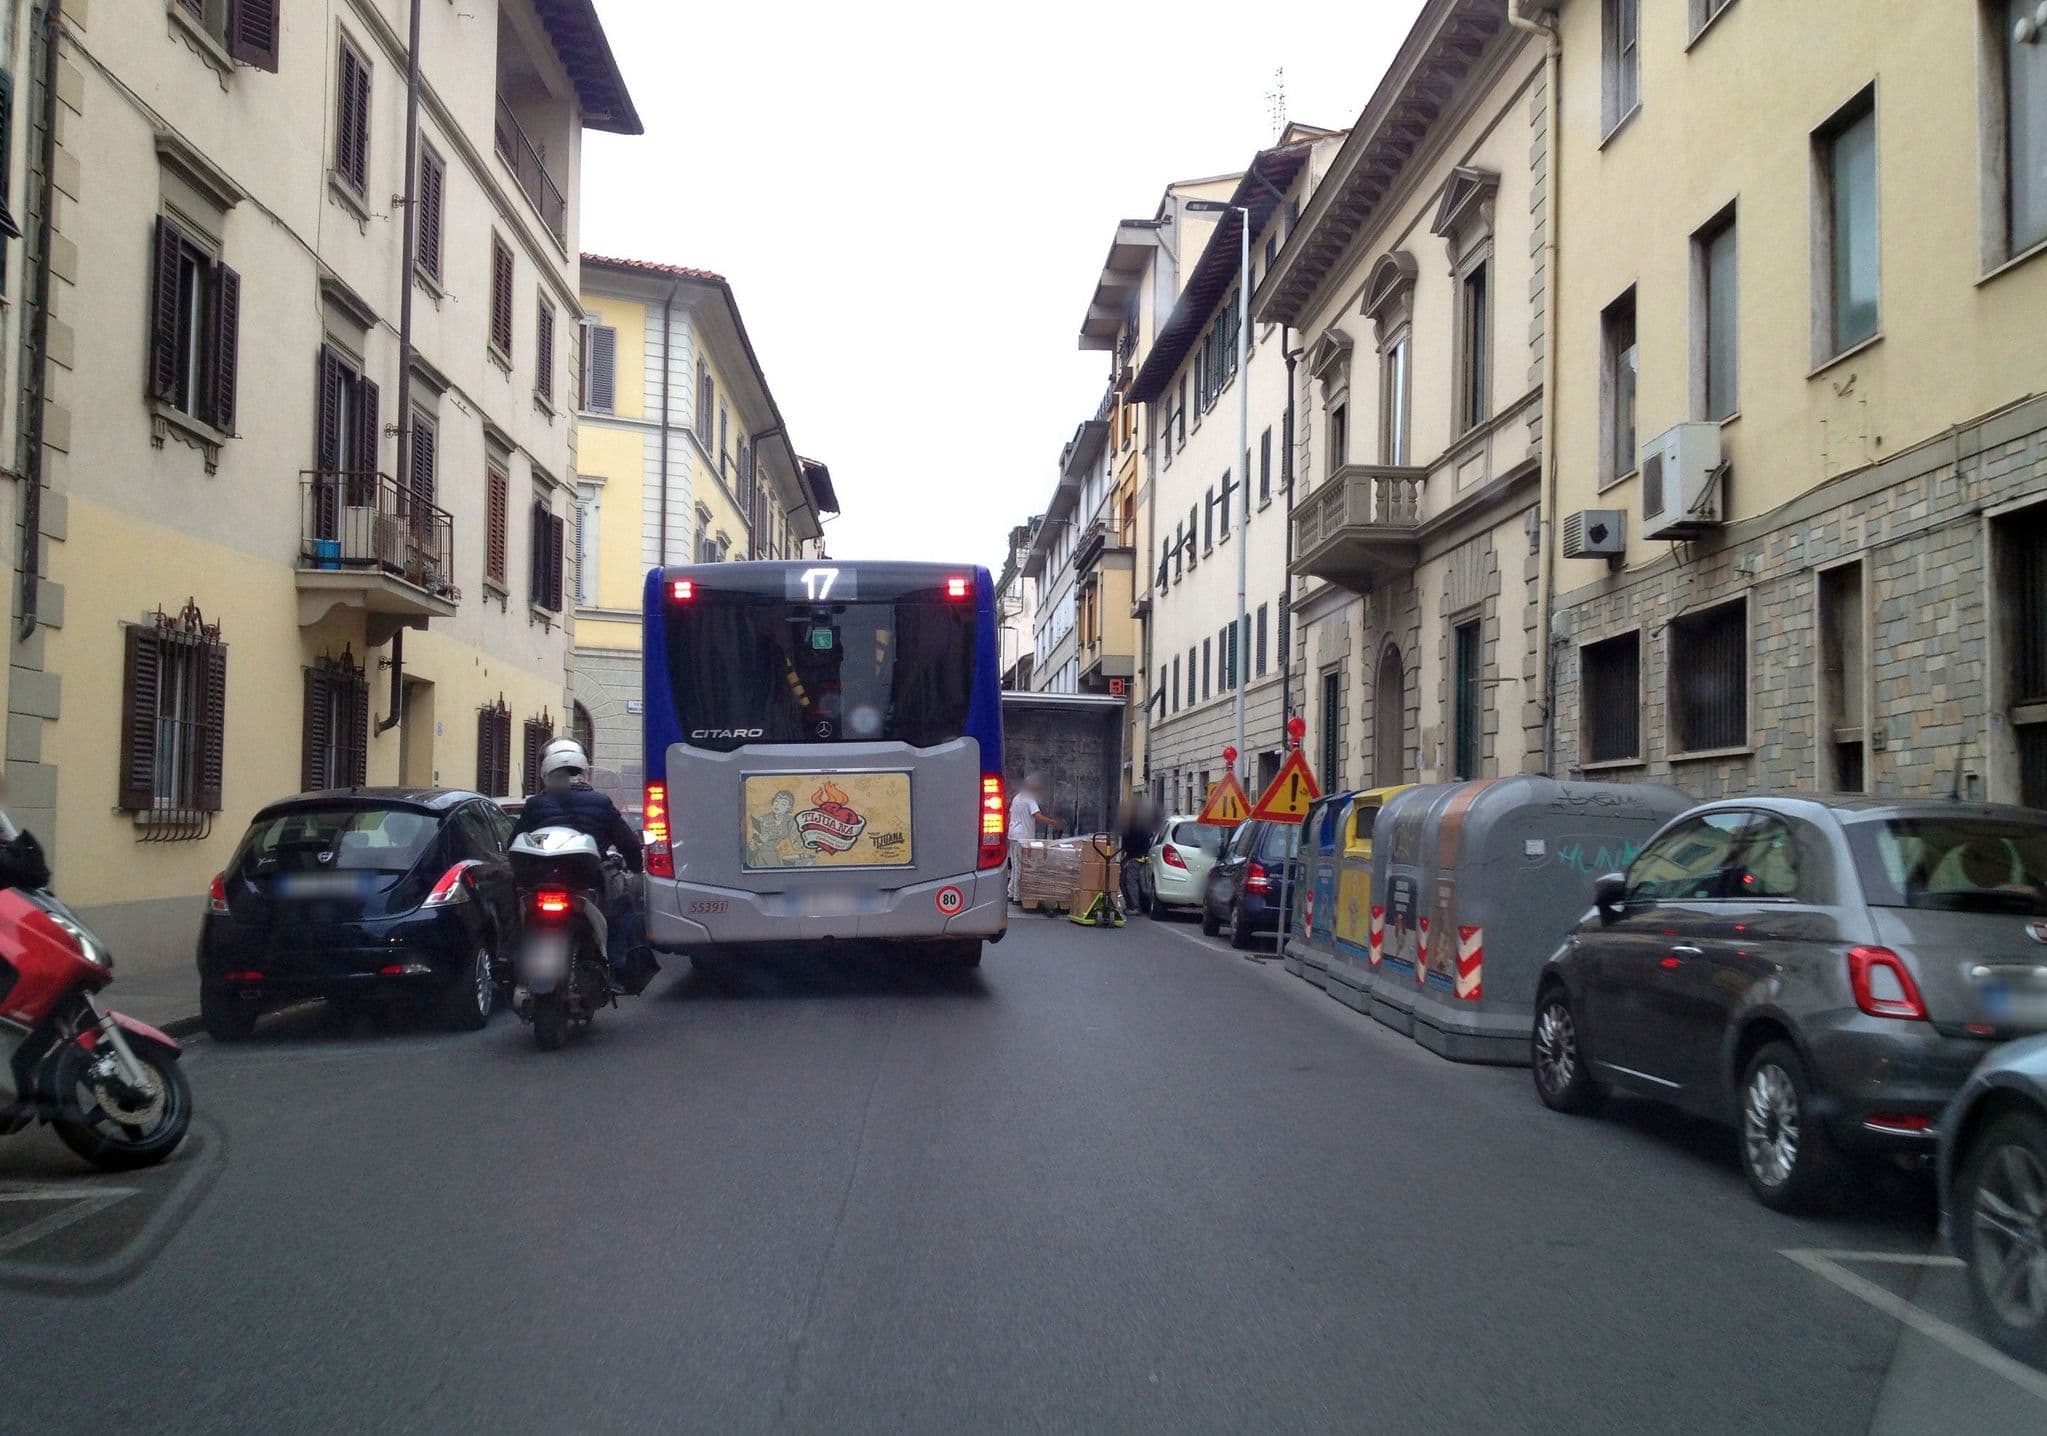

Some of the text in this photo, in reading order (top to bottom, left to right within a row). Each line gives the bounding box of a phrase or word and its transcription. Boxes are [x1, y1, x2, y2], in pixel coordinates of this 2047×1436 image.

[801, 568, 838, 600] 17
[691, 728, 763, 739] CITARO
[802, 811, 855, 835] TIJUANA
[943, 894, 956, 905] 80
